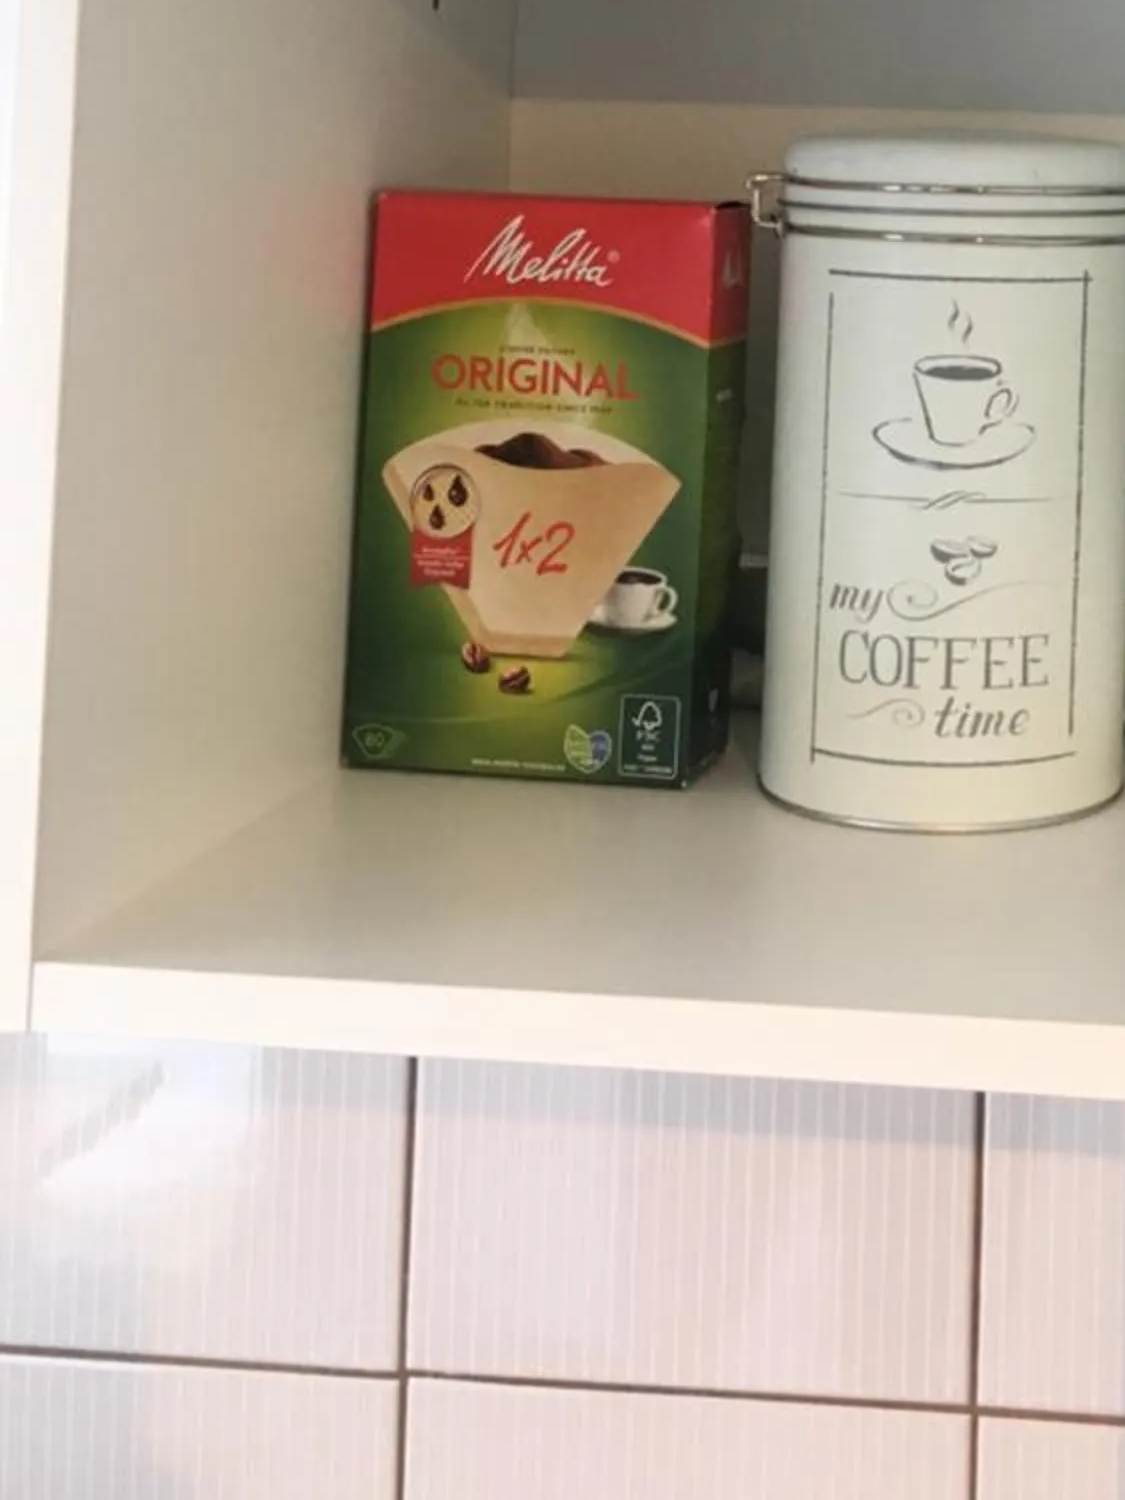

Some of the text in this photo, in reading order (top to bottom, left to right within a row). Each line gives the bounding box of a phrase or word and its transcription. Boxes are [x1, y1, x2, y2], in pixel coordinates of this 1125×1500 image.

[464, 214, 614, 288] Melitta
[432, 354, 640, 400] ORIGINAL
[493, 511, 575, 576] 1x2
[829, 582, 884, 623] my
[838, 630, 1050, 691] COFFEE
[933, 696, 1031, 739] time
